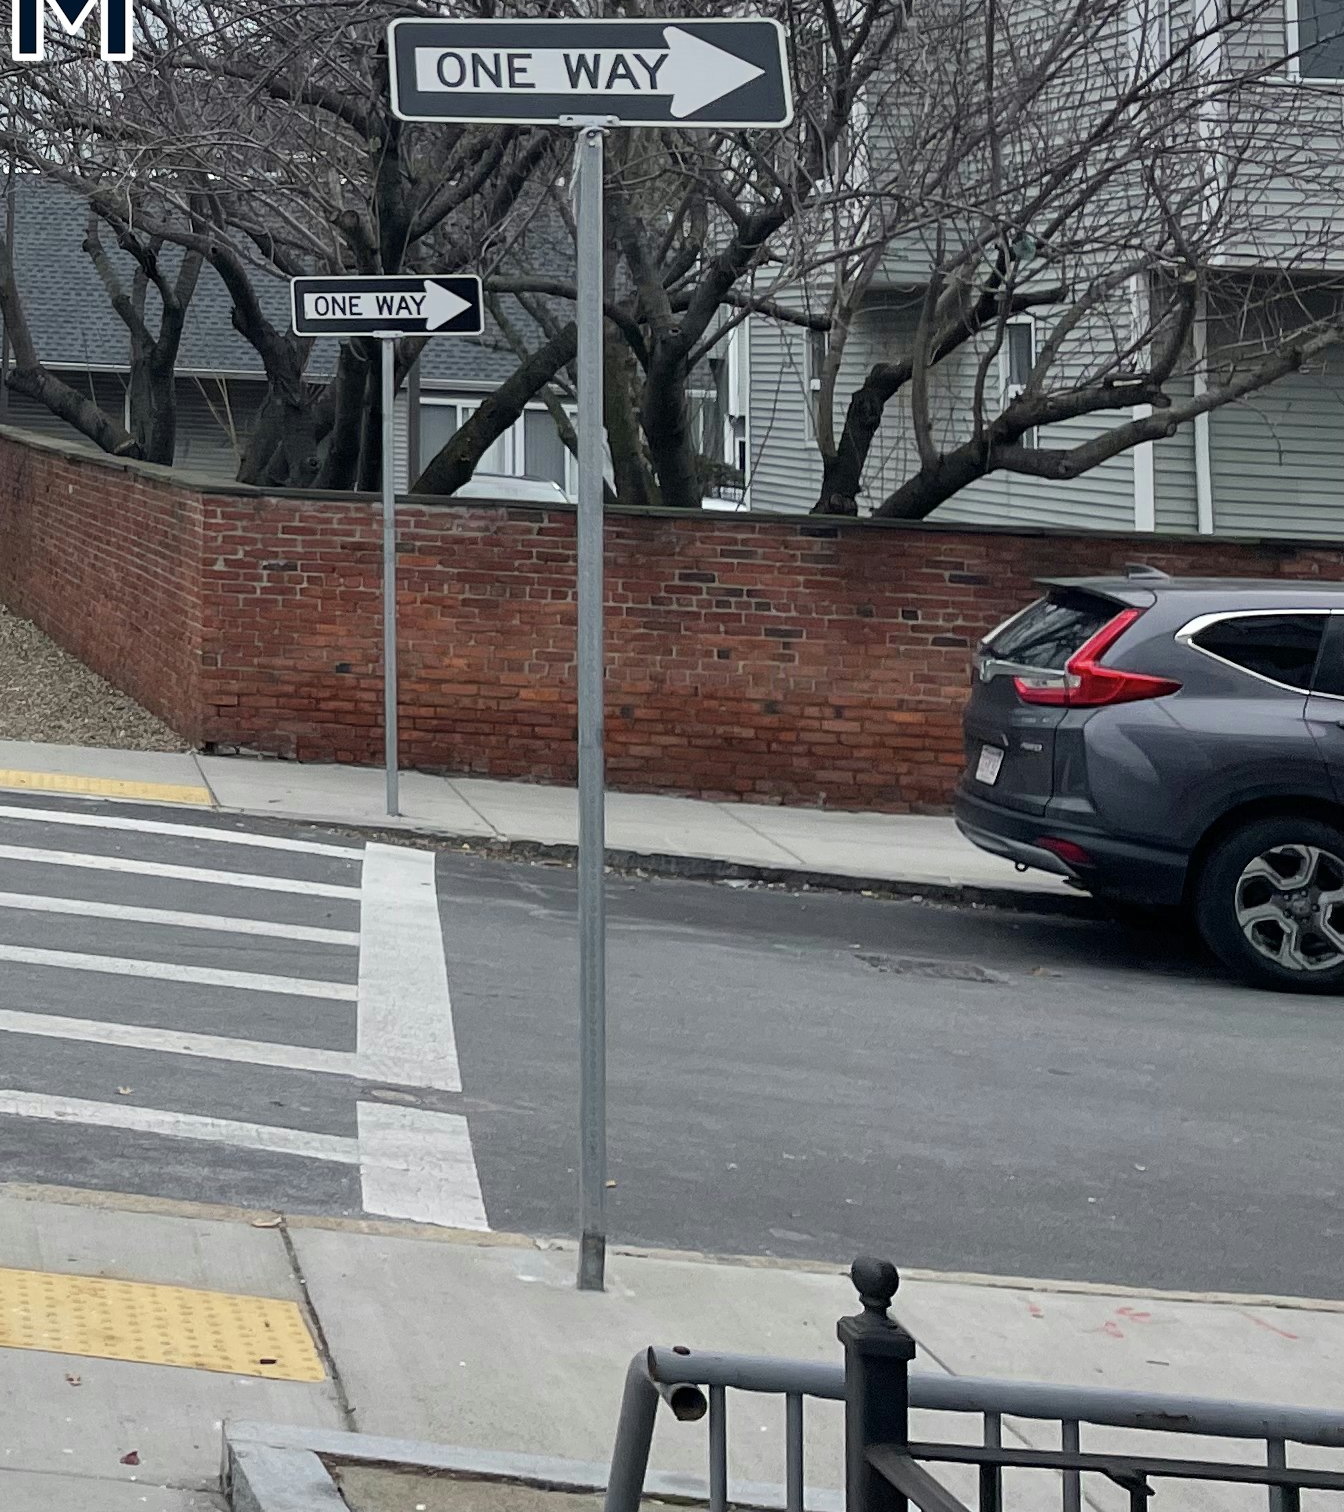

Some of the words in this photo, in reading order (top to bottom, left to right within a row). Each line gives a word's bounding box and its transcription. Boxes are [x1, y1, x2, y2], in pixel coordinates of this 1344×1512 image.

[436, 52, 536, 89] ONE
[562, 53, 670, 90] WAY
[314, 295, 363, 316] ONE
[375, 295, 427, 316] WAY
